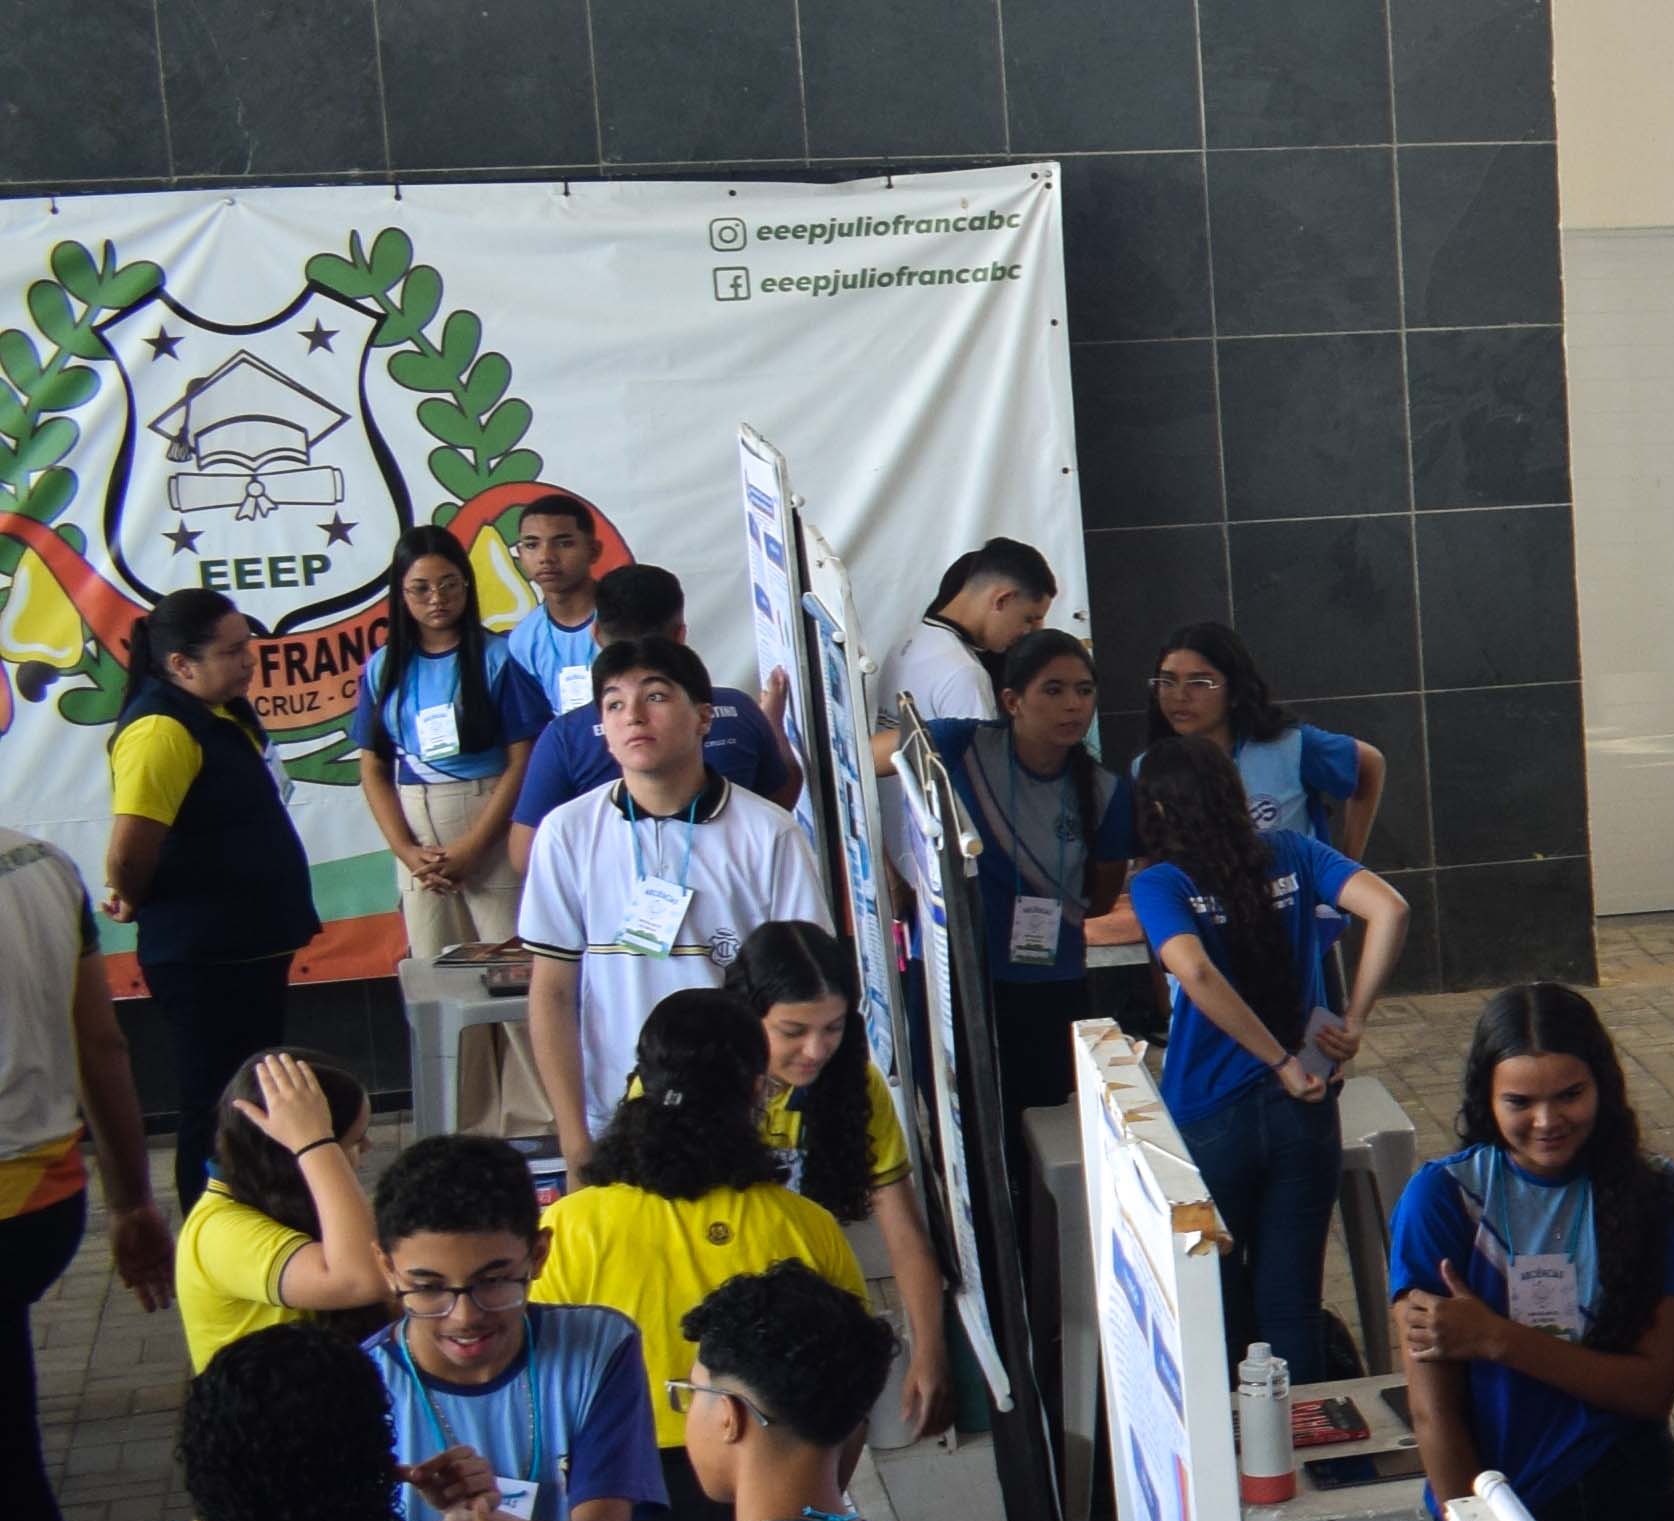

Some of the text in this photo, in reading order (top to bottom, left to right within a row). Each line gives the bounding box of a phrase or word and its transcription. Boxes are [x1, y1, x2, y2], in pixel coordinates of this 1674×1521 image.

[756, 211, 1021, 245] eeepjuliofrancabc
[760, 261, 1022, 297] eeepjuliofrancabc
[200, 554, 332, 591] EEEP
[258, 617, 391, 688] FRANC
[253, 690, 322, 717] CRUZ
